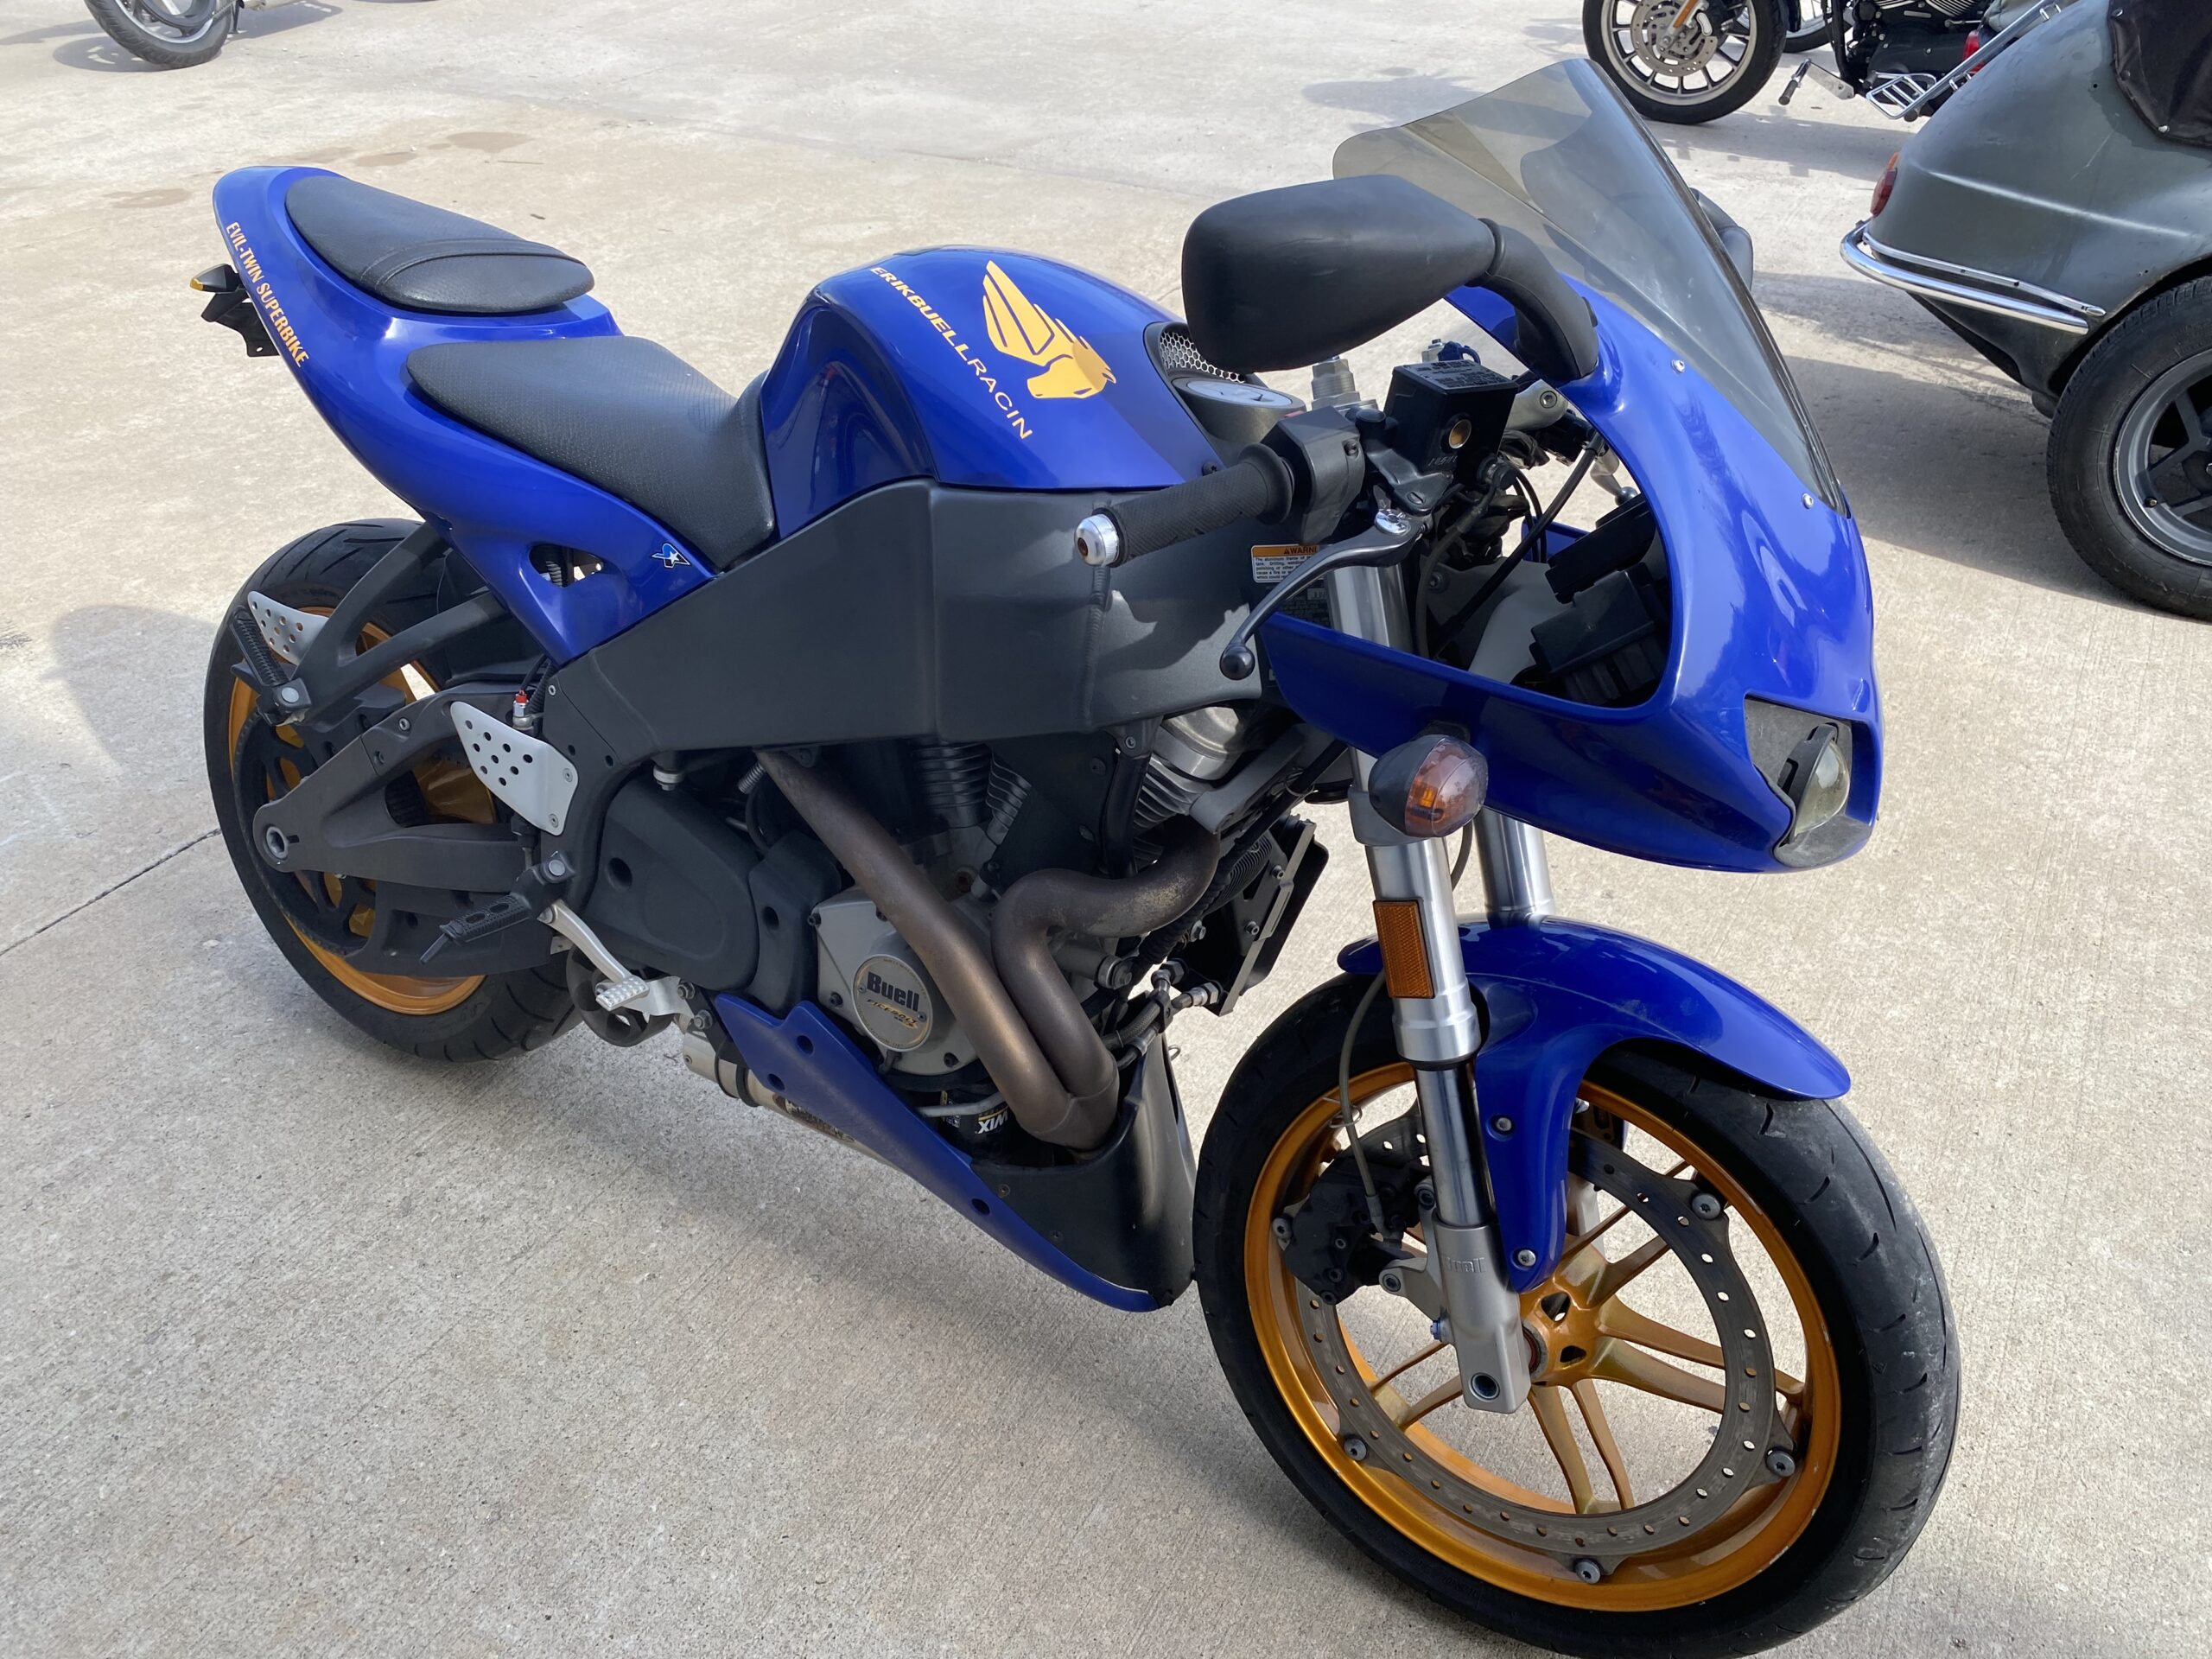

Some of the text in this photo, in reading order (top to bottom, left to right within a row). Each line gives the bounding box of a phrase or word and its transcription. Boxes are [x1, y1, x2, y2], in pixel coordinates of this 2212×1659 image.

[226, 221, 309, 367] EVIL-TWIN SUPERBIKE
[866, 971, 920, 1012] Buell
[977, 1110, 1008, 1134] WIX
